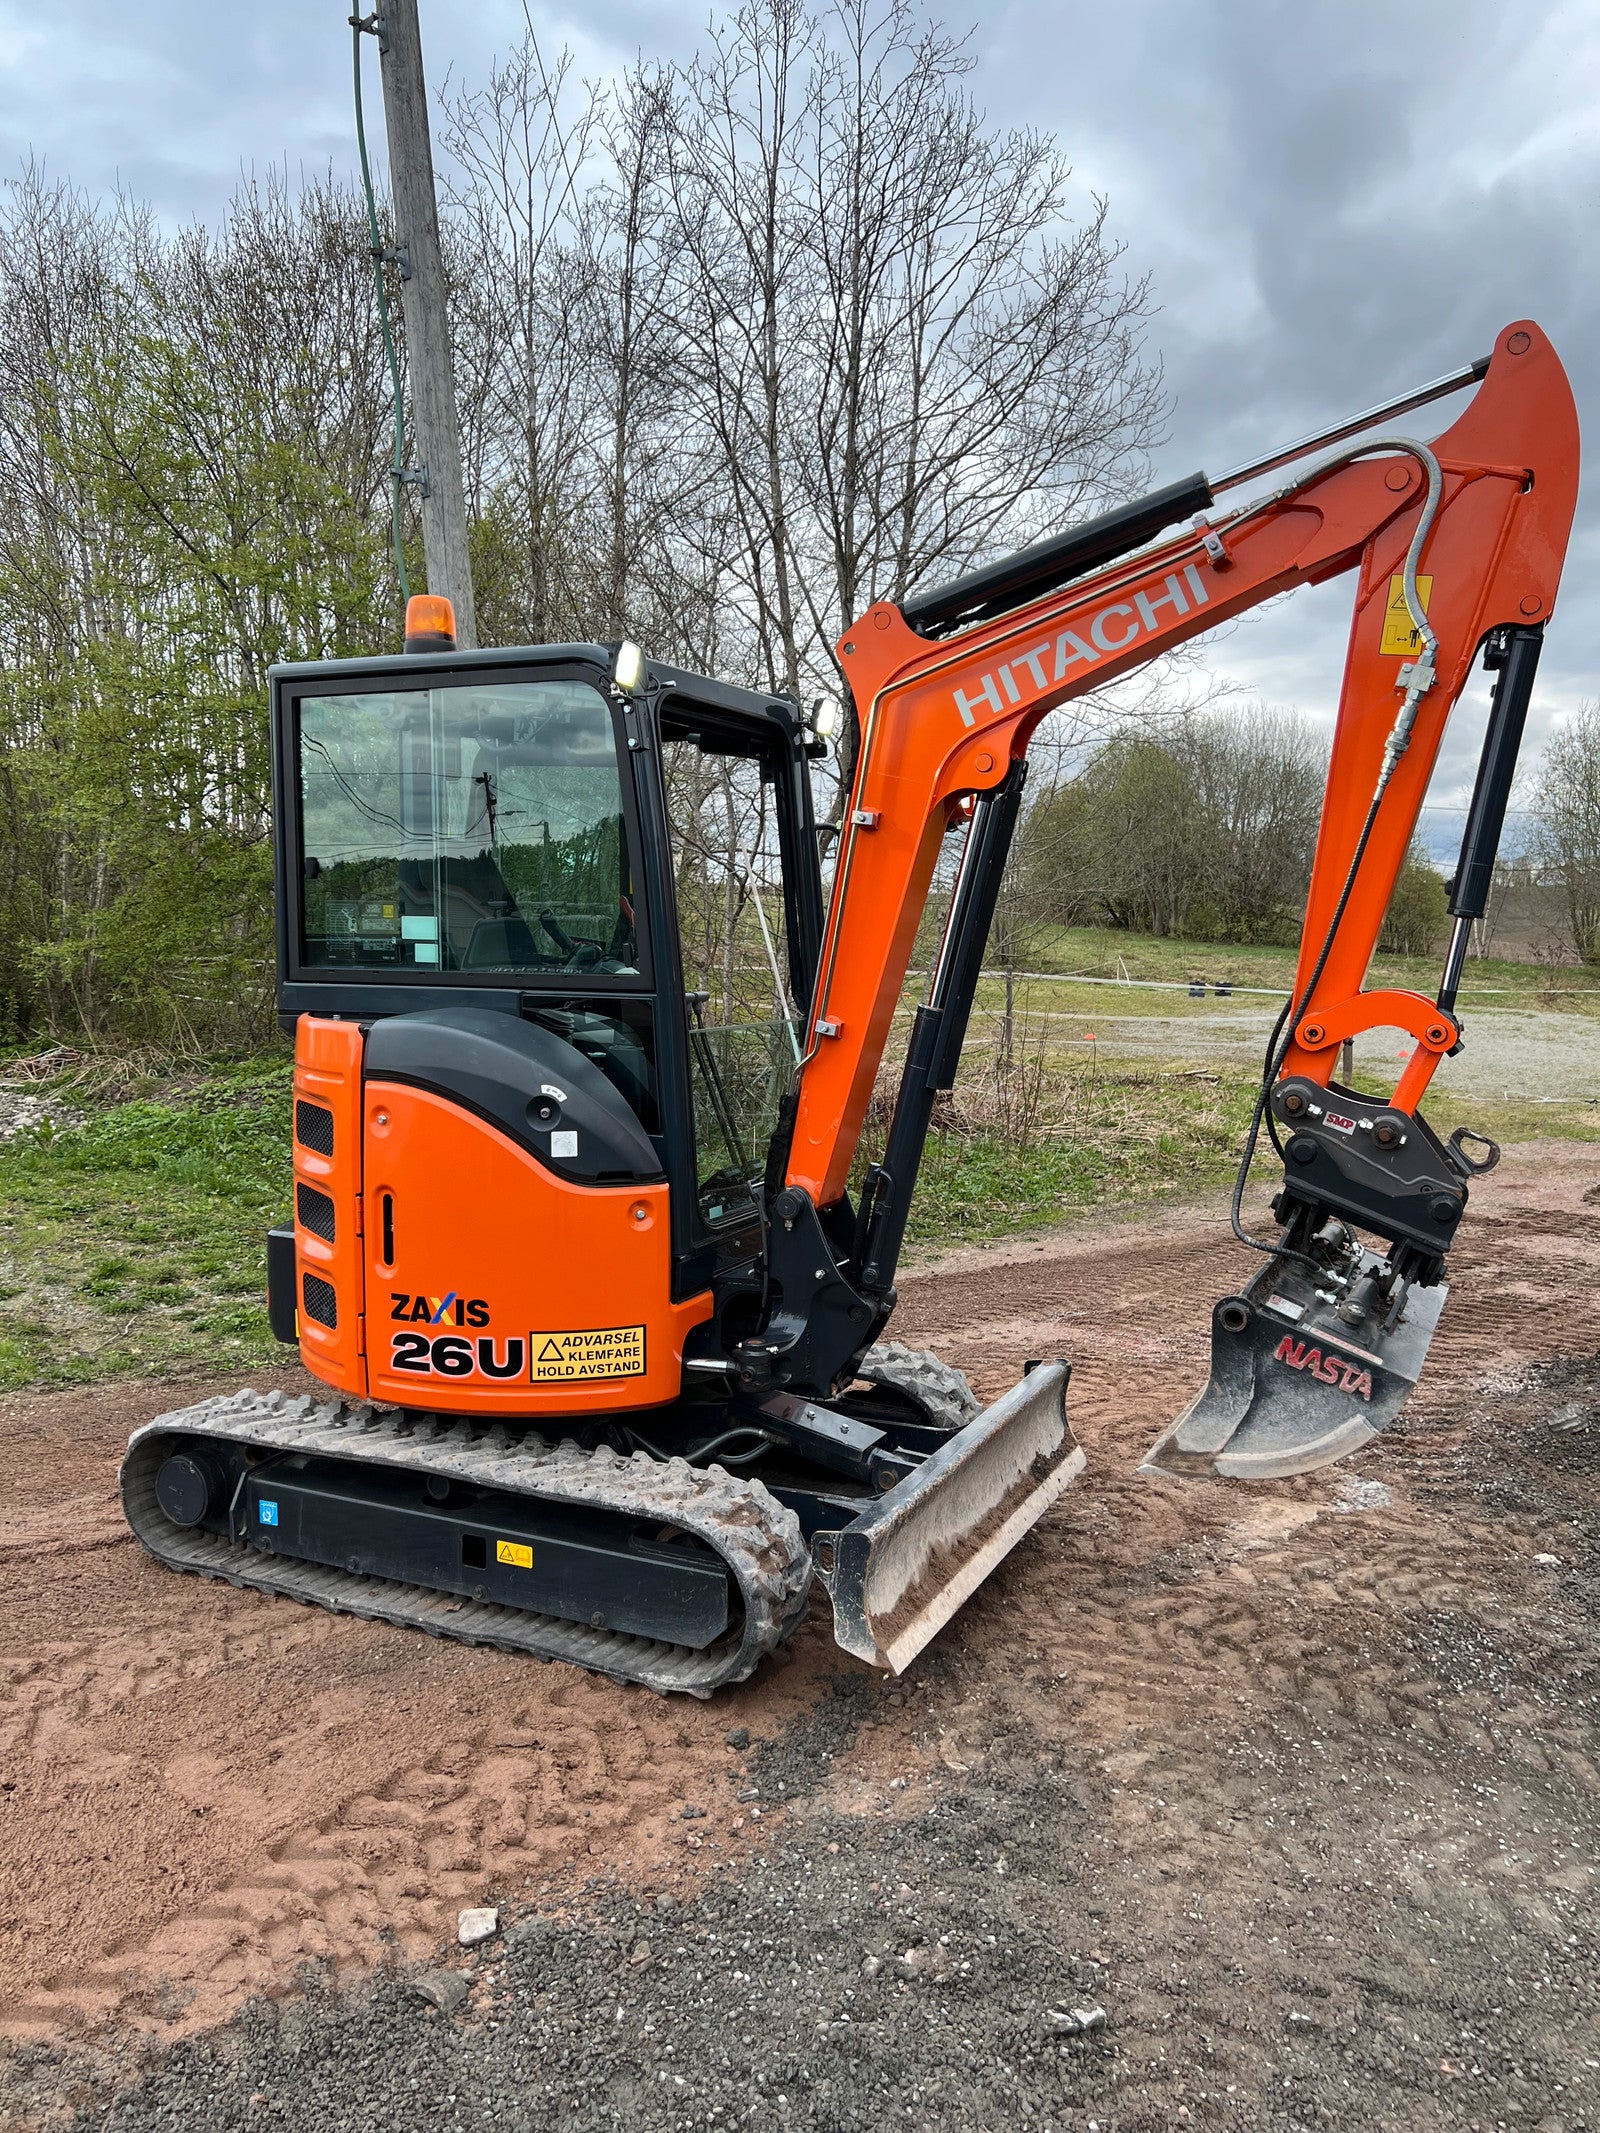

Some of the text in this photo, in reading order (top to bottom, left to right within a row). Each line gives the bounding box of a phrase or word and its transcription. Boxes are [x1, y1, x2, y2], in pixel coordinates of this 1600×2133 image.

[953, 563, 1209, 728] HITACHI
[391, 1292, 490, 1328] ZAXIS
[391, 1332, 524, 1379] 26U
[562, 1332, 640, 1348] ADVARSEL
[569, 1347, 641, 1362] KLEMFARE
[537, 1360, 641, 1377] HOLD AVSTAND
[1274, 1335, 1372, 1401] NASTA
